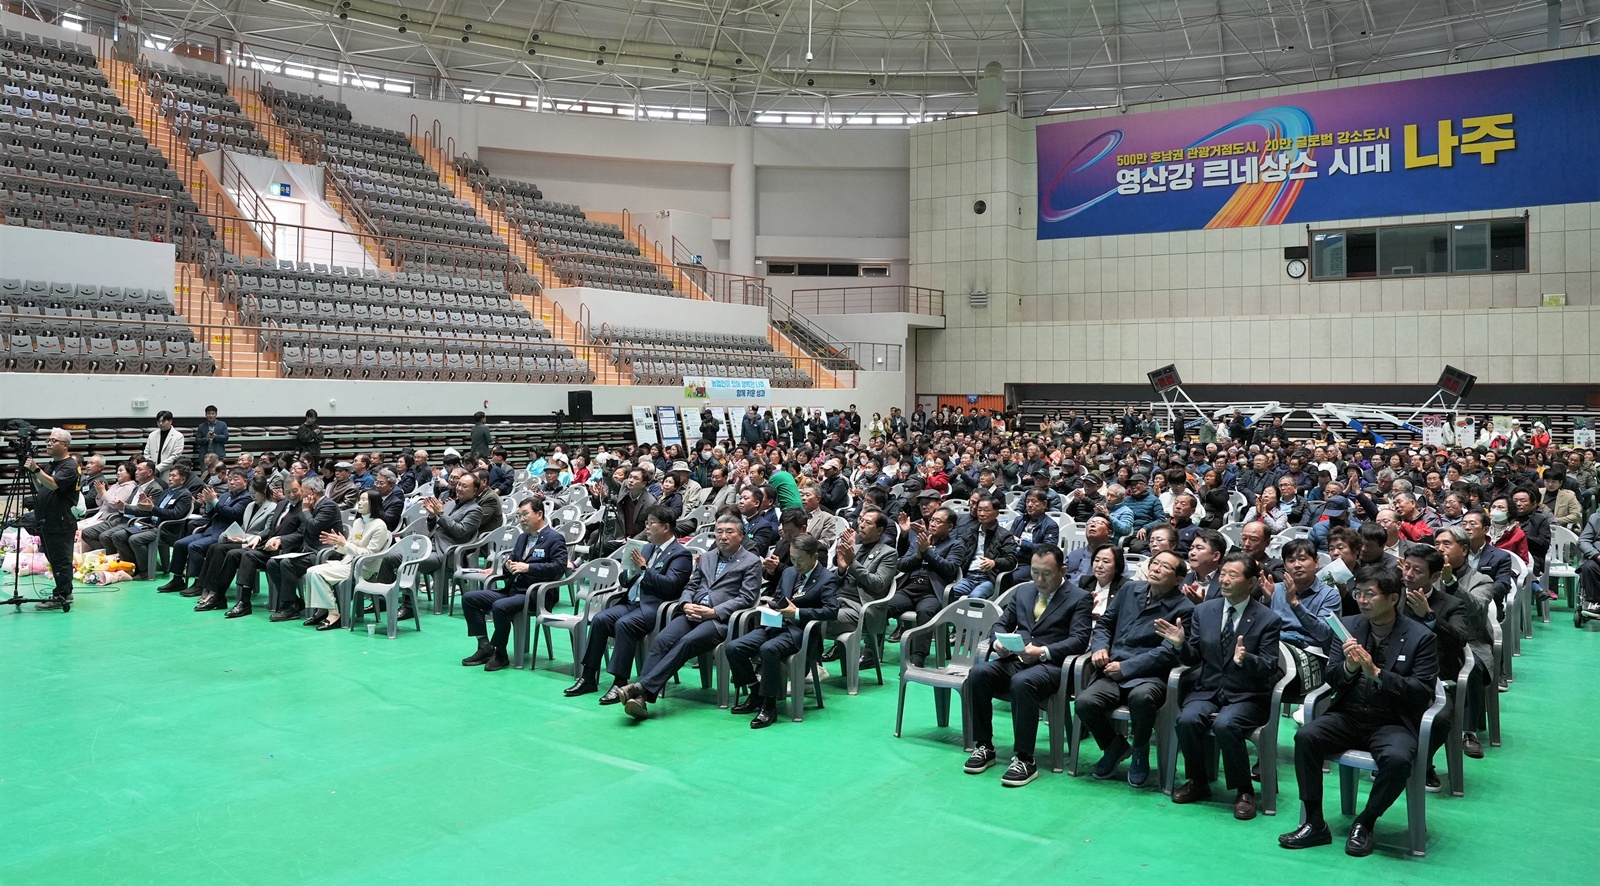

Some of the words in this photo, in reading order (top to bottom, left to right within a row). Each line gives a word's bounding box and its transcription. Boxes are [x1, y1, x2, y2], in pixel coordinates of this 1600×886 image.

[1116, 153, 1148, 167] 500만
[1150, 148, 1184, 163] 호남권
[1186, 141, 1260, 160] 관광거점도시,
[1265, 138, 1293, 152] 20만
[1296, 132, 1333, 149] 글로벌
[1336, 126, 1390, 145] 강소도시
[1116, 162, 1195, 195] 영산강
[1202, 151, 1318, 188] 르네상스
[1328, 143, 1390, 176] 시대
[1403, 113, 1516, 169] 나주
